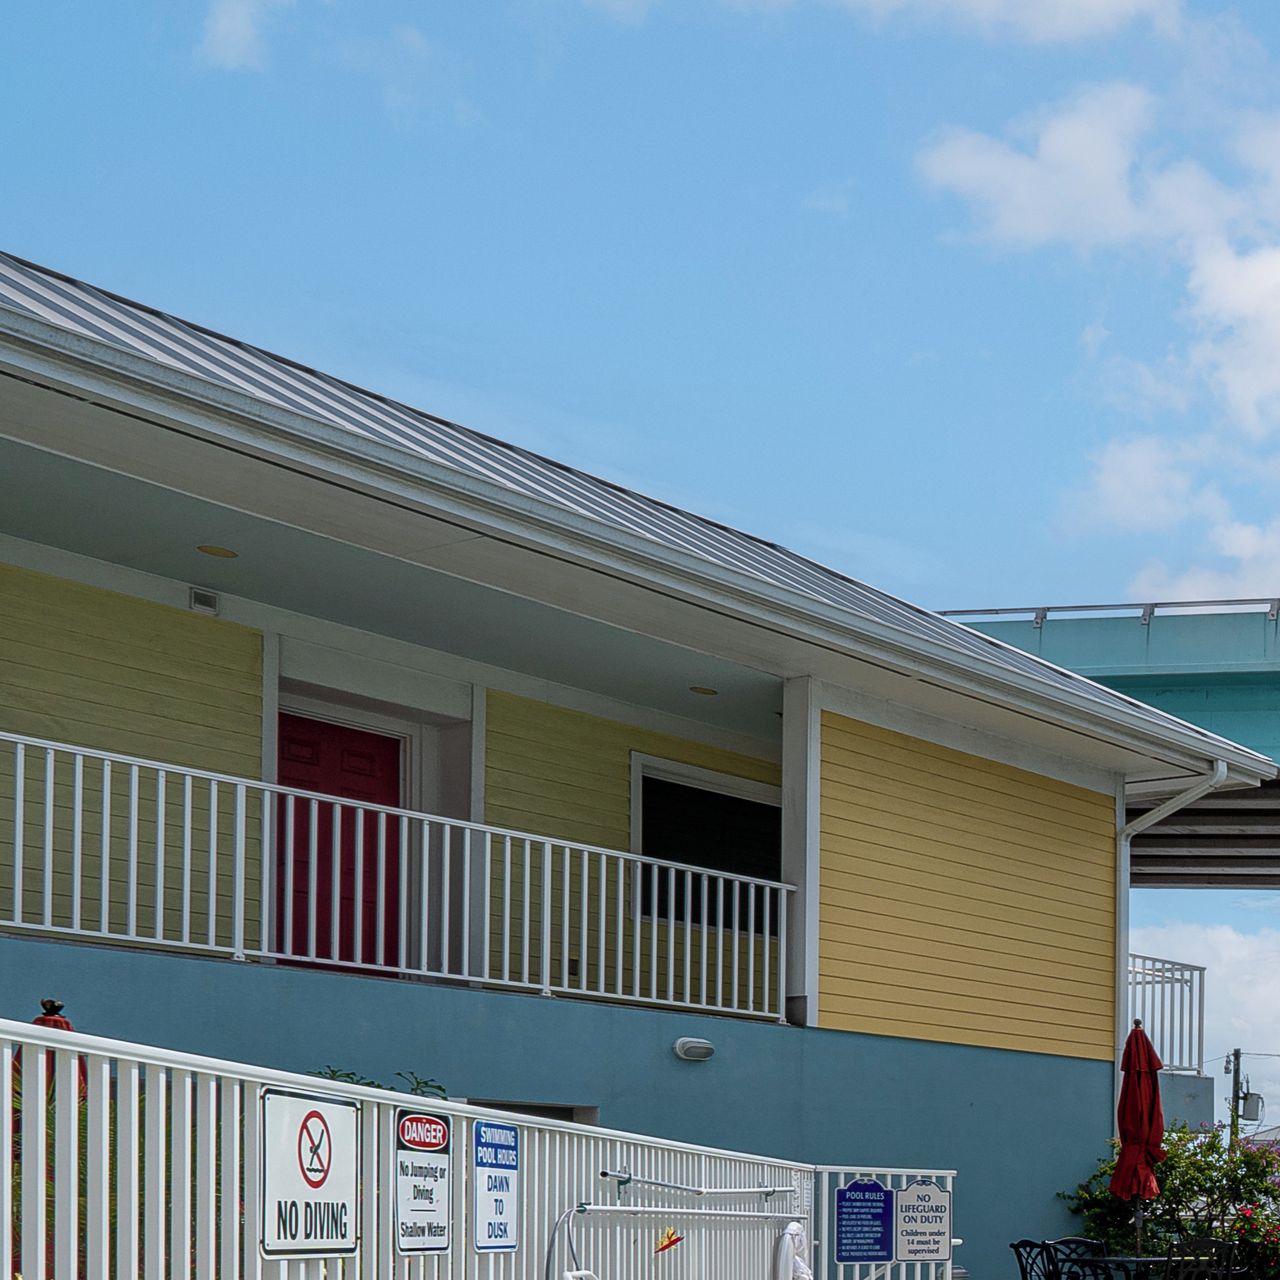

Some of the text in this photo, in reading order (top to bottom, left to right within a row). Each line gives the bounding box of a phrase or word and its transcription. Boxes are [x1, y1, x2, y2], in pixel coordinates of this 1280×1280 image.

[404, 1120, 444, 1144] DANGER
[480, 1126, 516, 1146] SWIMMING
[477, 1147, 517, 1166] POOL HOURS
[399, 1160, 447, 1183] No Jumping or
[487, 1174, 510, 1193] DAWN
[413, 1184, 434, 1204] Diving
[846, 1192, 885, 1200] POOL RULES
[916, 1194, 931, 1203] NO
[494, 1198, 504, 1216] TO
[900, 1204, 947, 1214] LIFEGUARD
[277, 1200, 348, 1241] NO DIVING
[903, 1215, 944, 1224] ON DUTY
[400, 1222, 447, 1238] Shallow Water
[487, 1222, 509, 1239] DUSK
[901, 1229, 946, 1237] Children under
[907, 1247, 940, 1256] supervised
